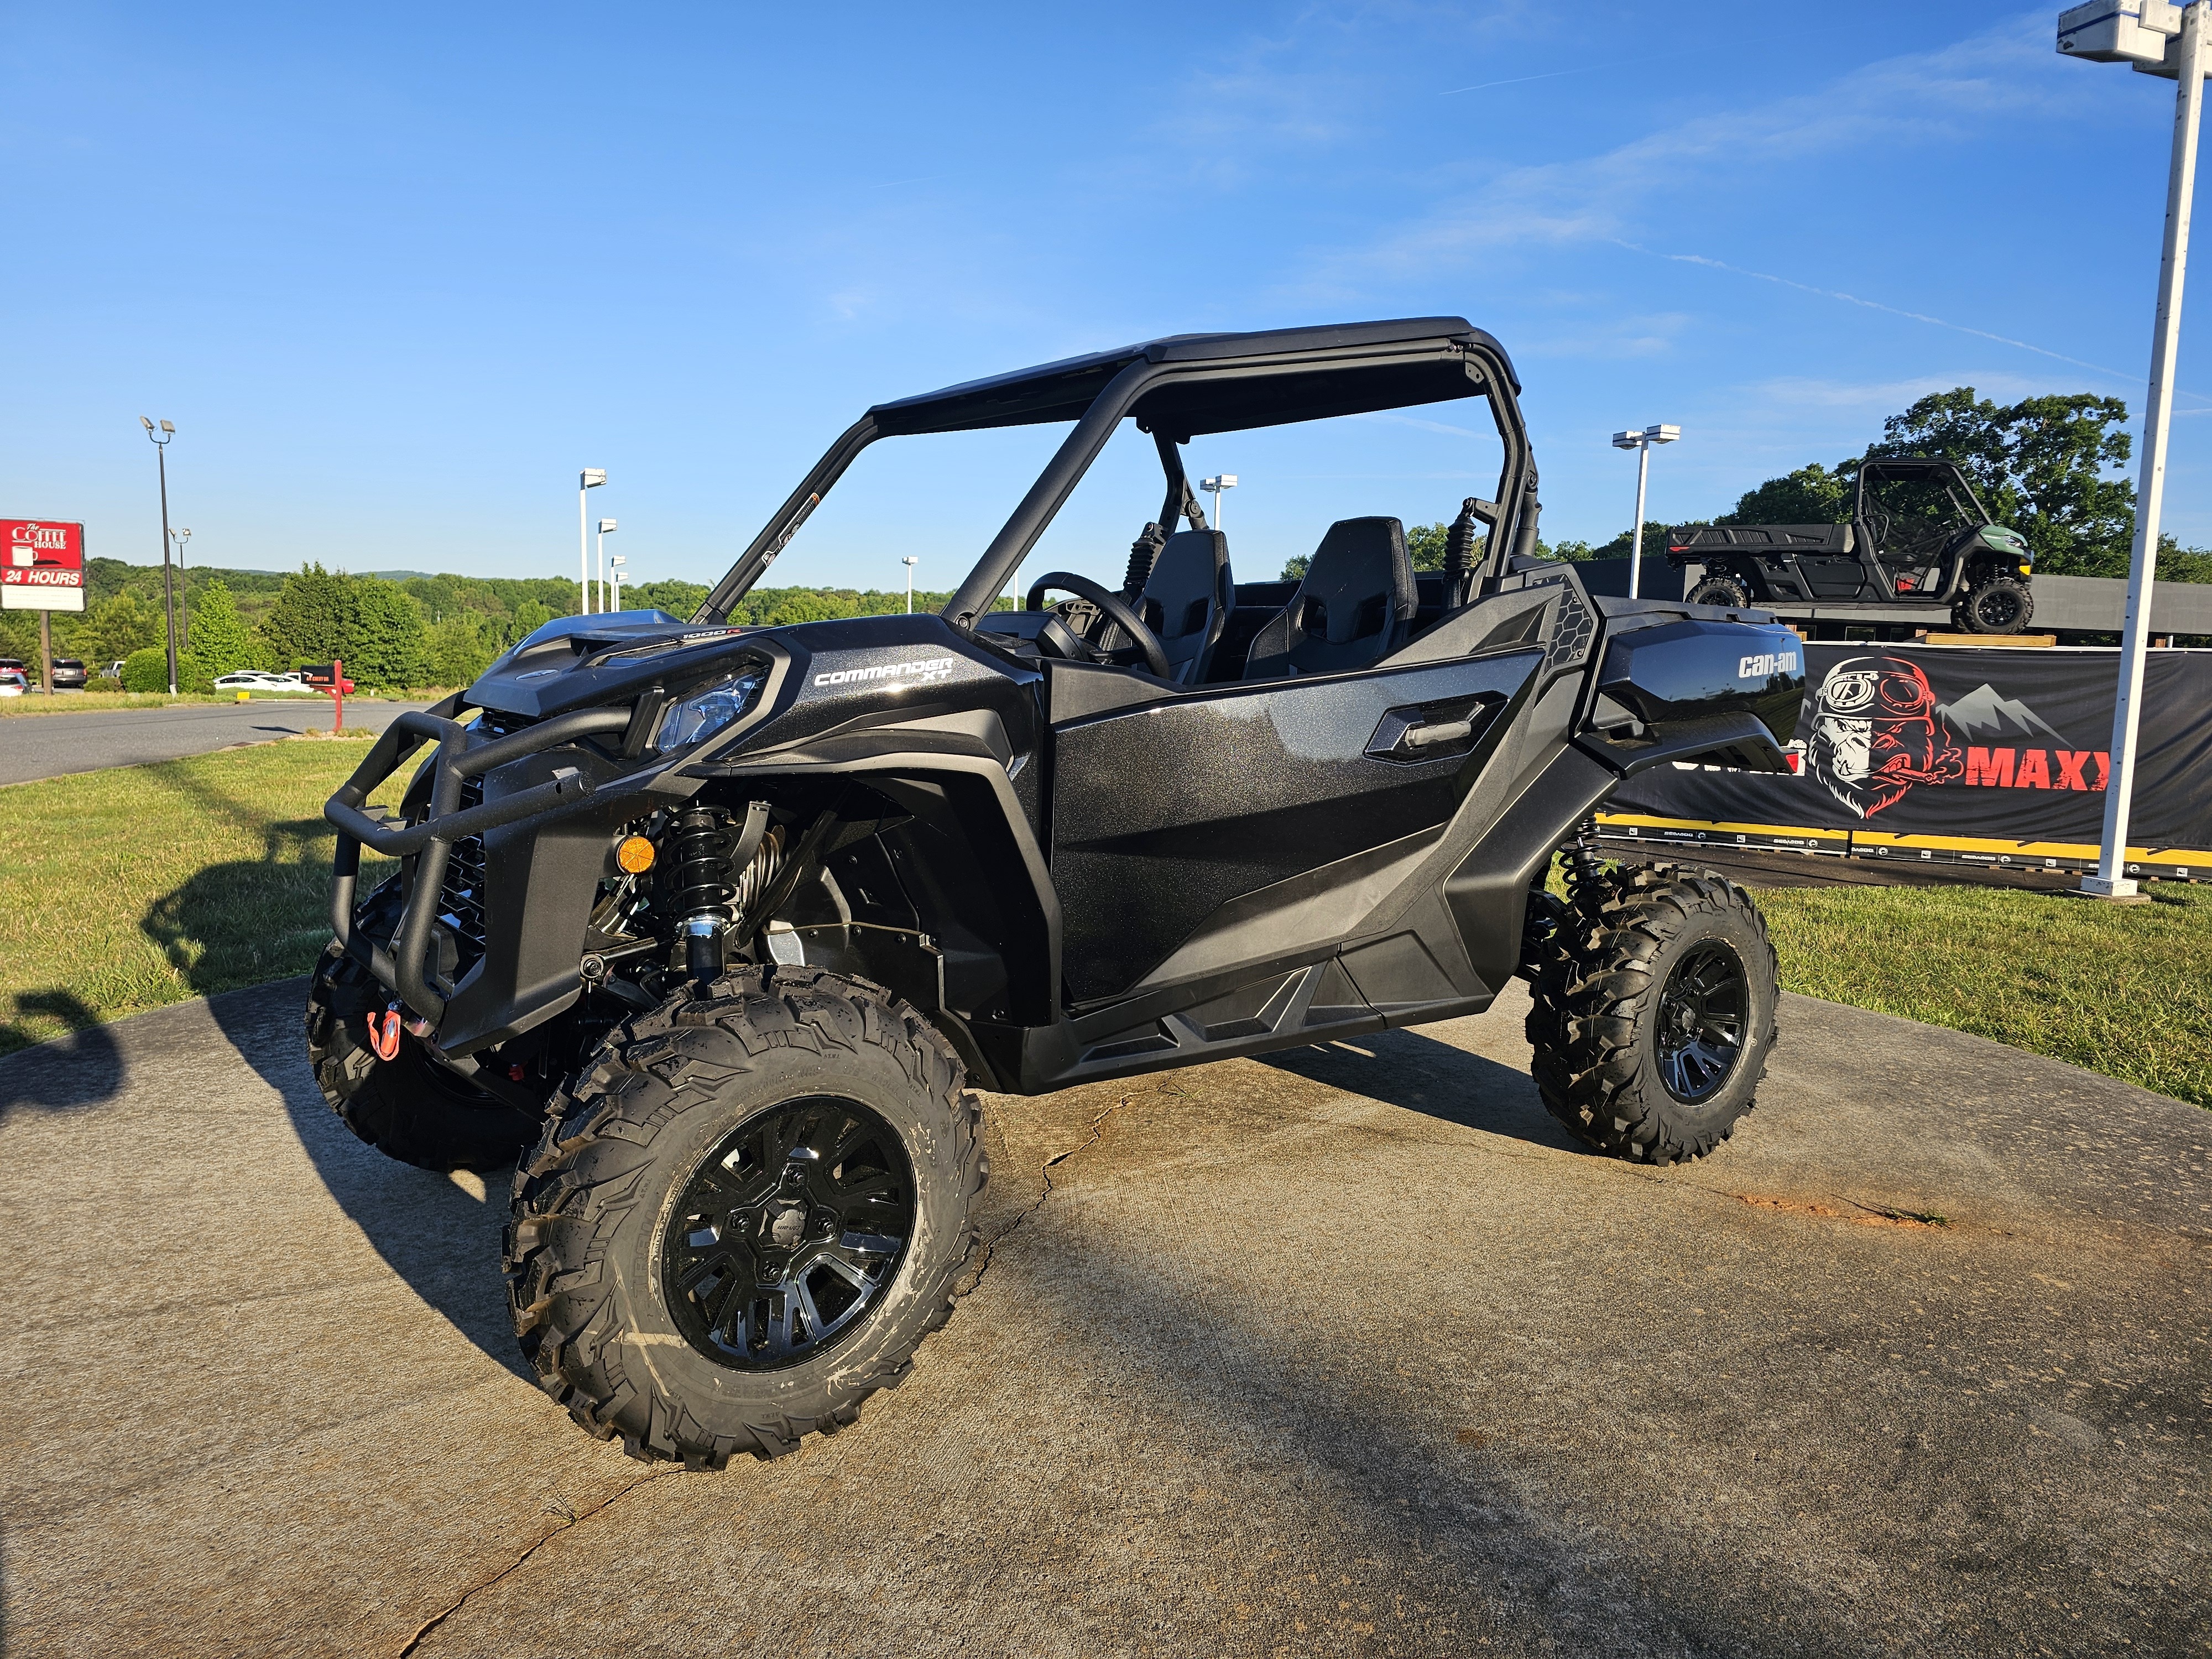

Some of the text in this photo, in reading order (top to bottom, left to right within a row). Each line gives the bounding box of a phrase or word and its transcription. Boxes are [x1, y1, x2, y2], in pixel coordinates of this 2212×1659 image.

[34, 541, 66, 549] HOUSE
[6, 570, 80, 585] 24 HOURS
[683, 629, 741, 639] 1000R
[814, 657, 954, 686] COMMANDER
[920, 668, 952, 681] XT
